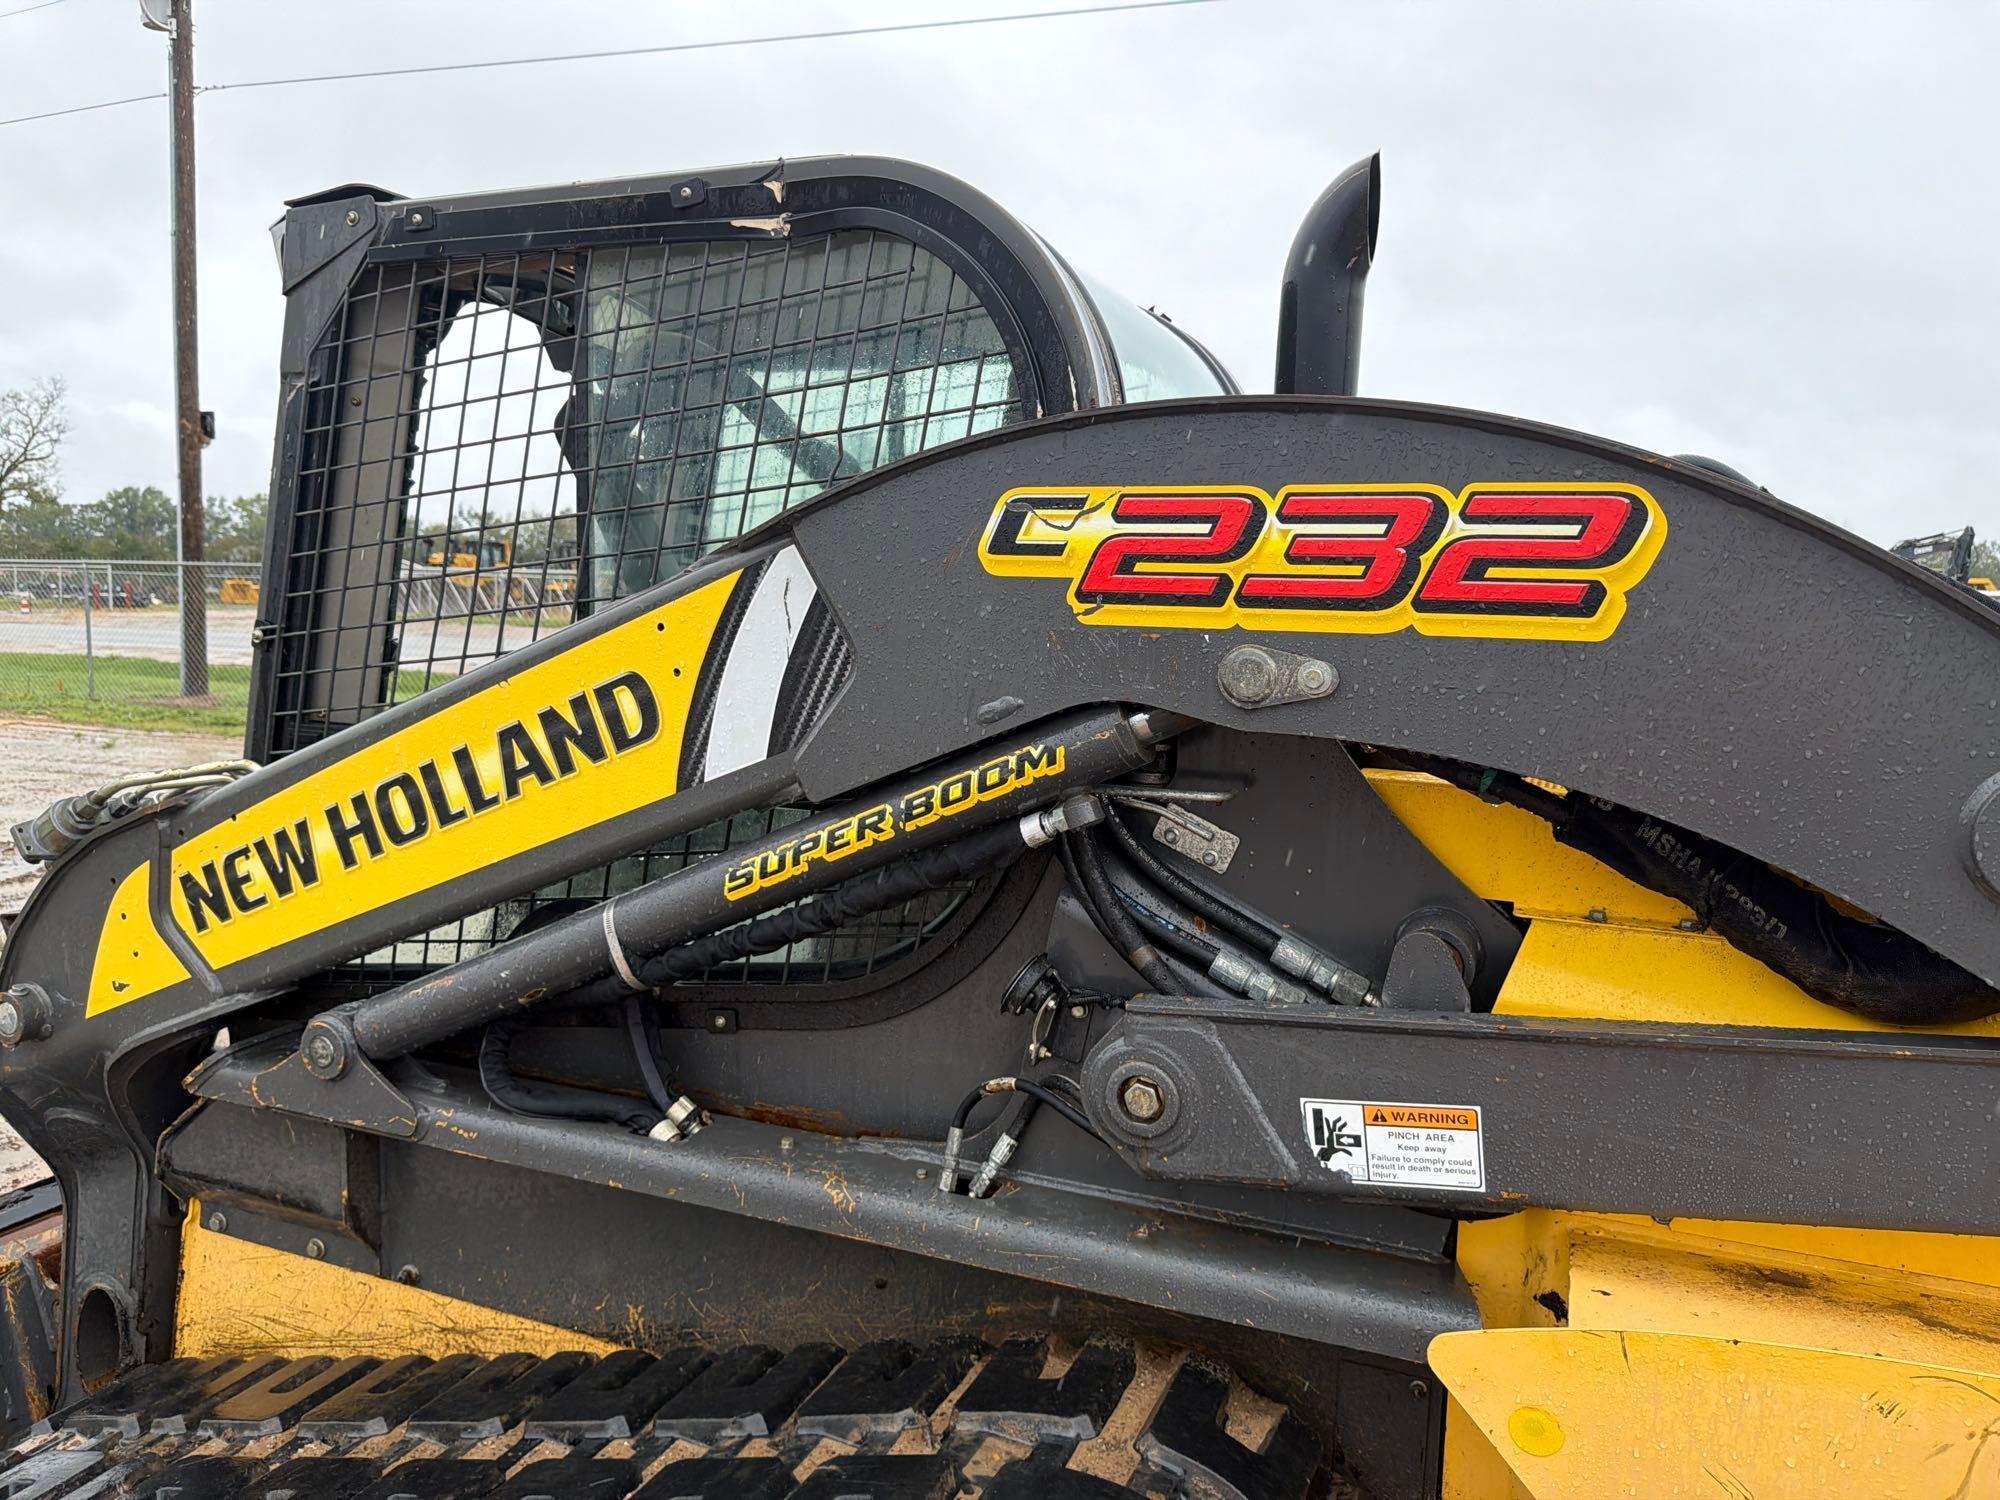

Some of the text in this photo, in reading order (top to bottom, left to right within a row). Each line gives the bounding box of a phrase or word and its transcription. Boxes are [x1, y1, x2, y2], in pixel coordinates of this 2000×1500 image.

[983, 489, 1657, 625] C232
[178, 671, 663, 935] NEW HOLLAND
[724, 744, 1065, 900] SUPER BOOM
[1635, 816, 1703, 873] MSHA
[1391, 1111, 1469, 1125] WARNING
[1388, 1132, 1455, 1143] PINCH AREA
[1397, 1143, 1447, 1154] Keep away
[1371, 1154, 1400, 1163] Failure
[1413, 1157, 1446, 1166] comply
[1448, 1158, 1473, 1167] could
[1372, 1162, 1396, 1170] result
[1398, 1163, 1406, 1171] in
[1408, 1164, 1431, 1172] death
[1444, 1166, 1477, 1175] serious
[1372, 1170, 1399, 1180] injury.
